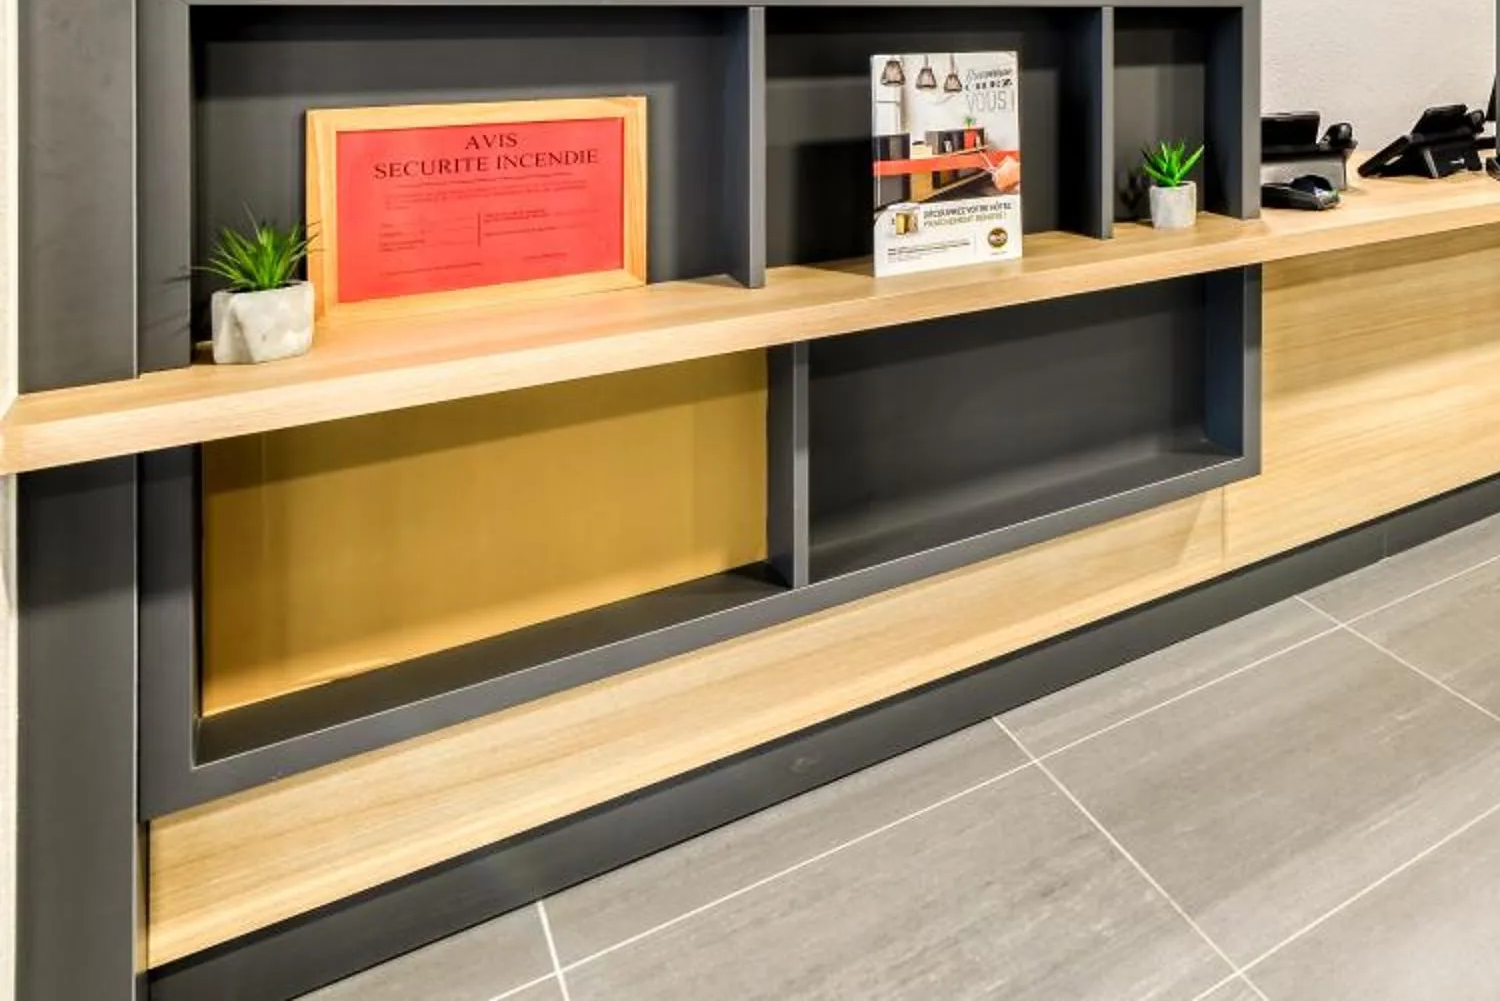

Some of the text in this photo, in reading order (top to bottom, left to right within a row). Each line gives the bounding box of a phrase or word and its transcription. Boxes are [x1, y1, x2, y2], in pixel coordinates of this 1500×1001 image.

[464, 132, 518, 150] AVIS
[373, 148, 598, 179] SECURITE INCENDIE
